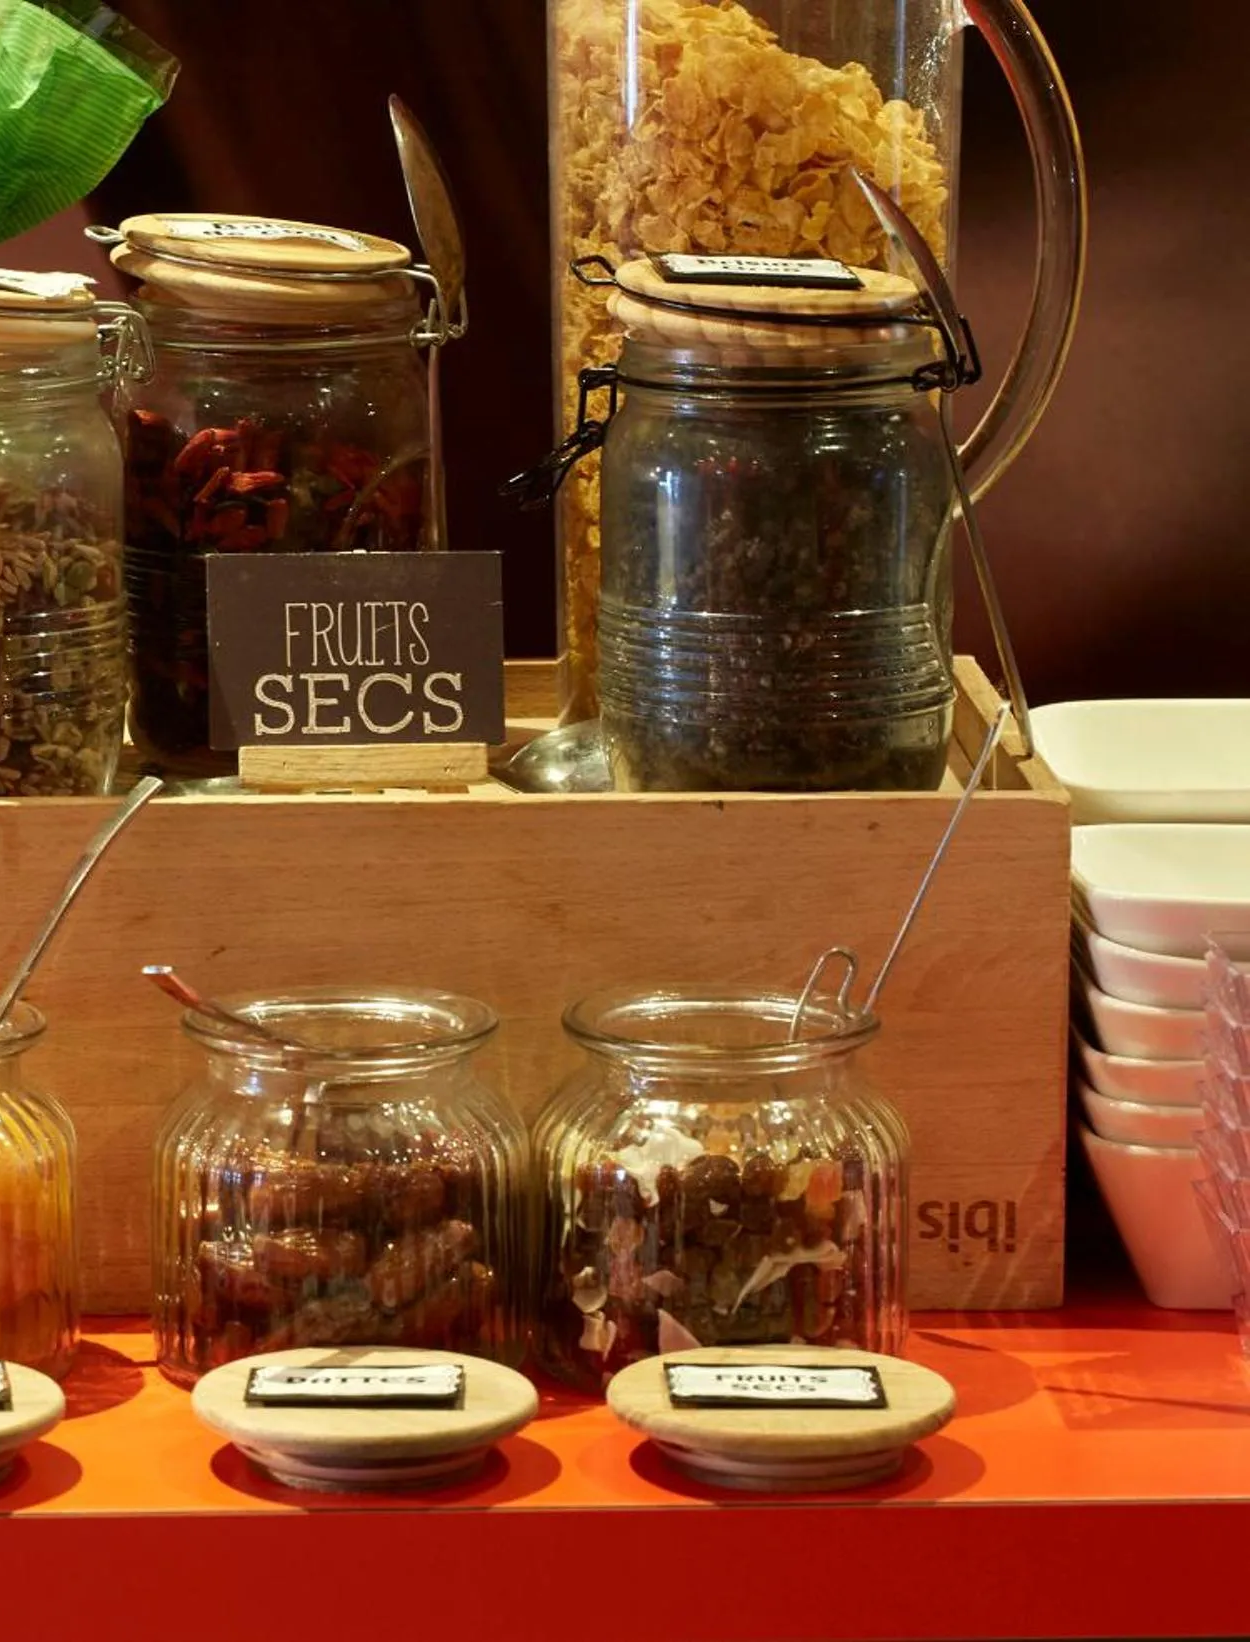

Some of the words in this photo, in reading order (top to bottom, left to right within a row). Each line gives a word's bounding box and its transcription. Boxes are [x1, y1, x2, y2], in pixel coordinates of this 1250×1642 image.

[284, 600, 430, 668] FRUITS
[254, 672, 465, 736] SECS
[917, 1200, 1017, 1253] ibis
